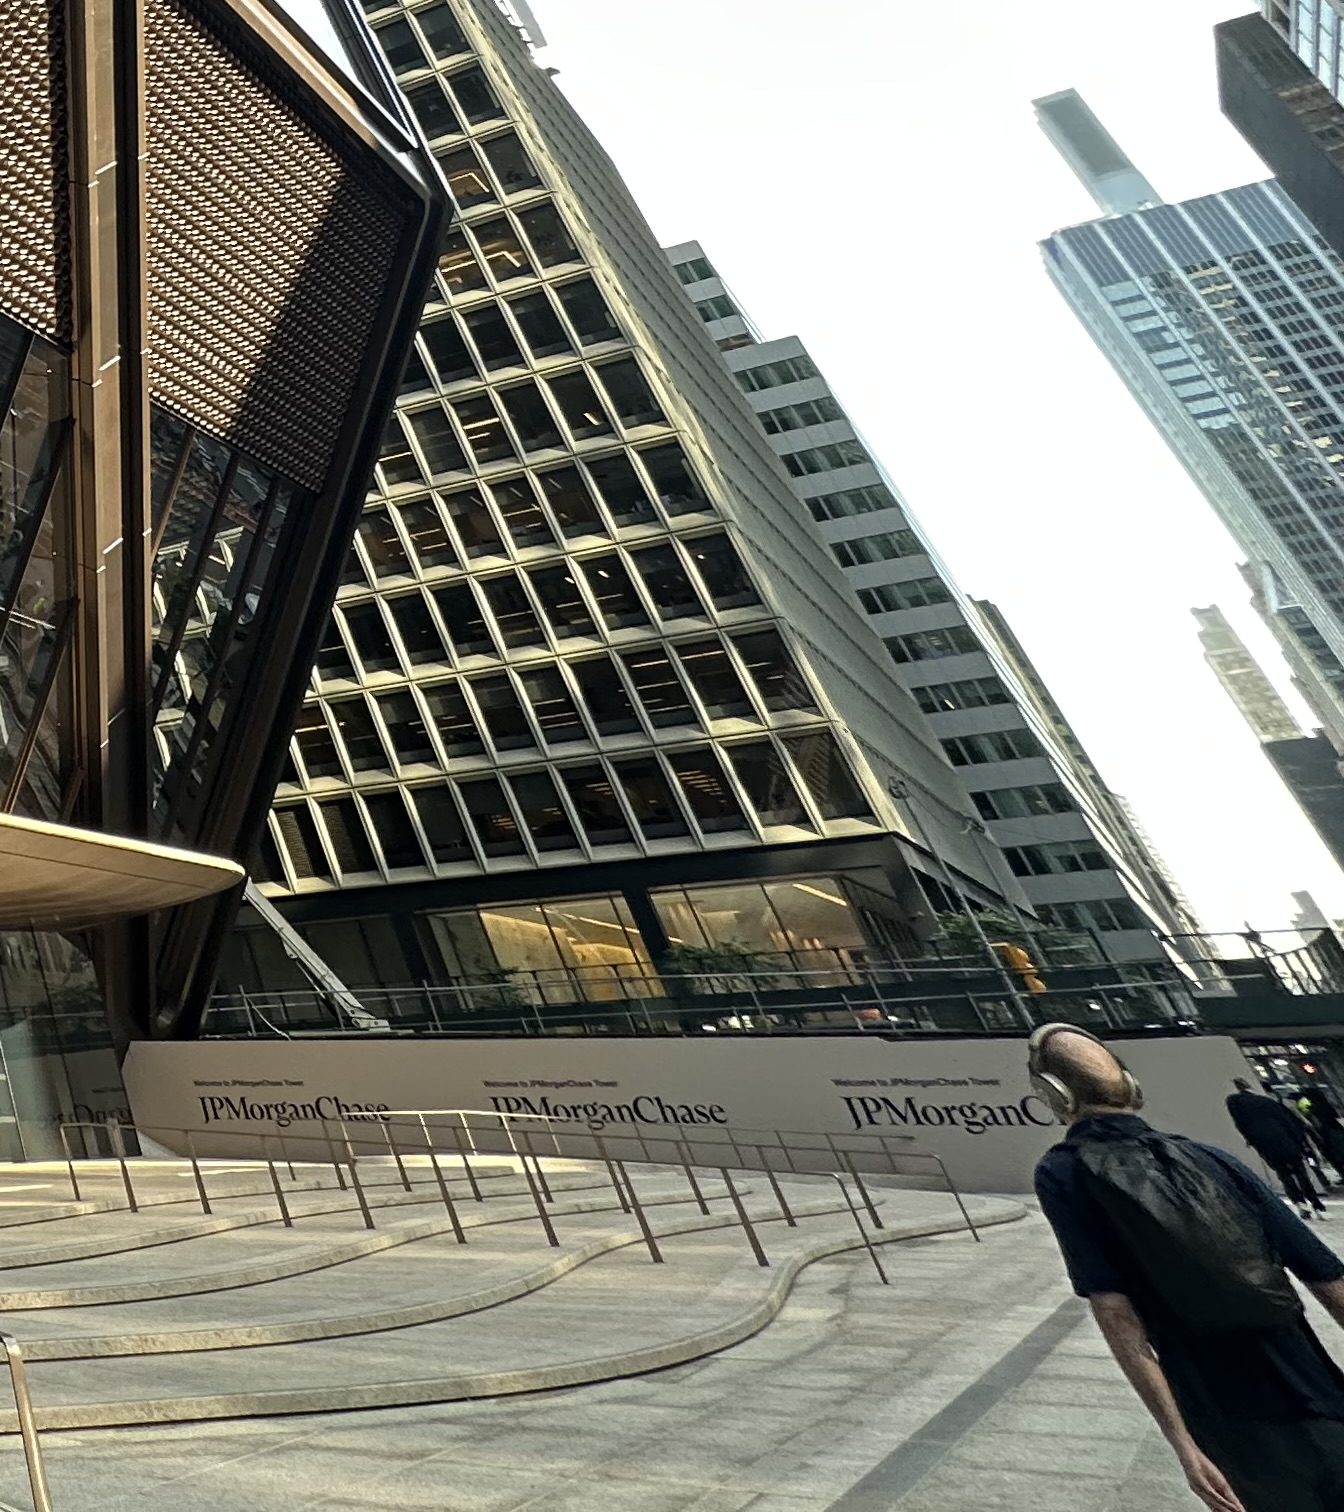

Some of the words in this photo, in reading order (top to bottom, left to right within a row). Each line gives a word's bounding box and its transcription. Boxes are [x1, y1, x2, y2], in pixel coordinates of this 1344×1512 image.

[198, 1095, 392, 1128] JPMorganChase
[489, 1095, 728, 1131] JPMorganChase
[841, 1095, 1068, 1135] JPMorganC
